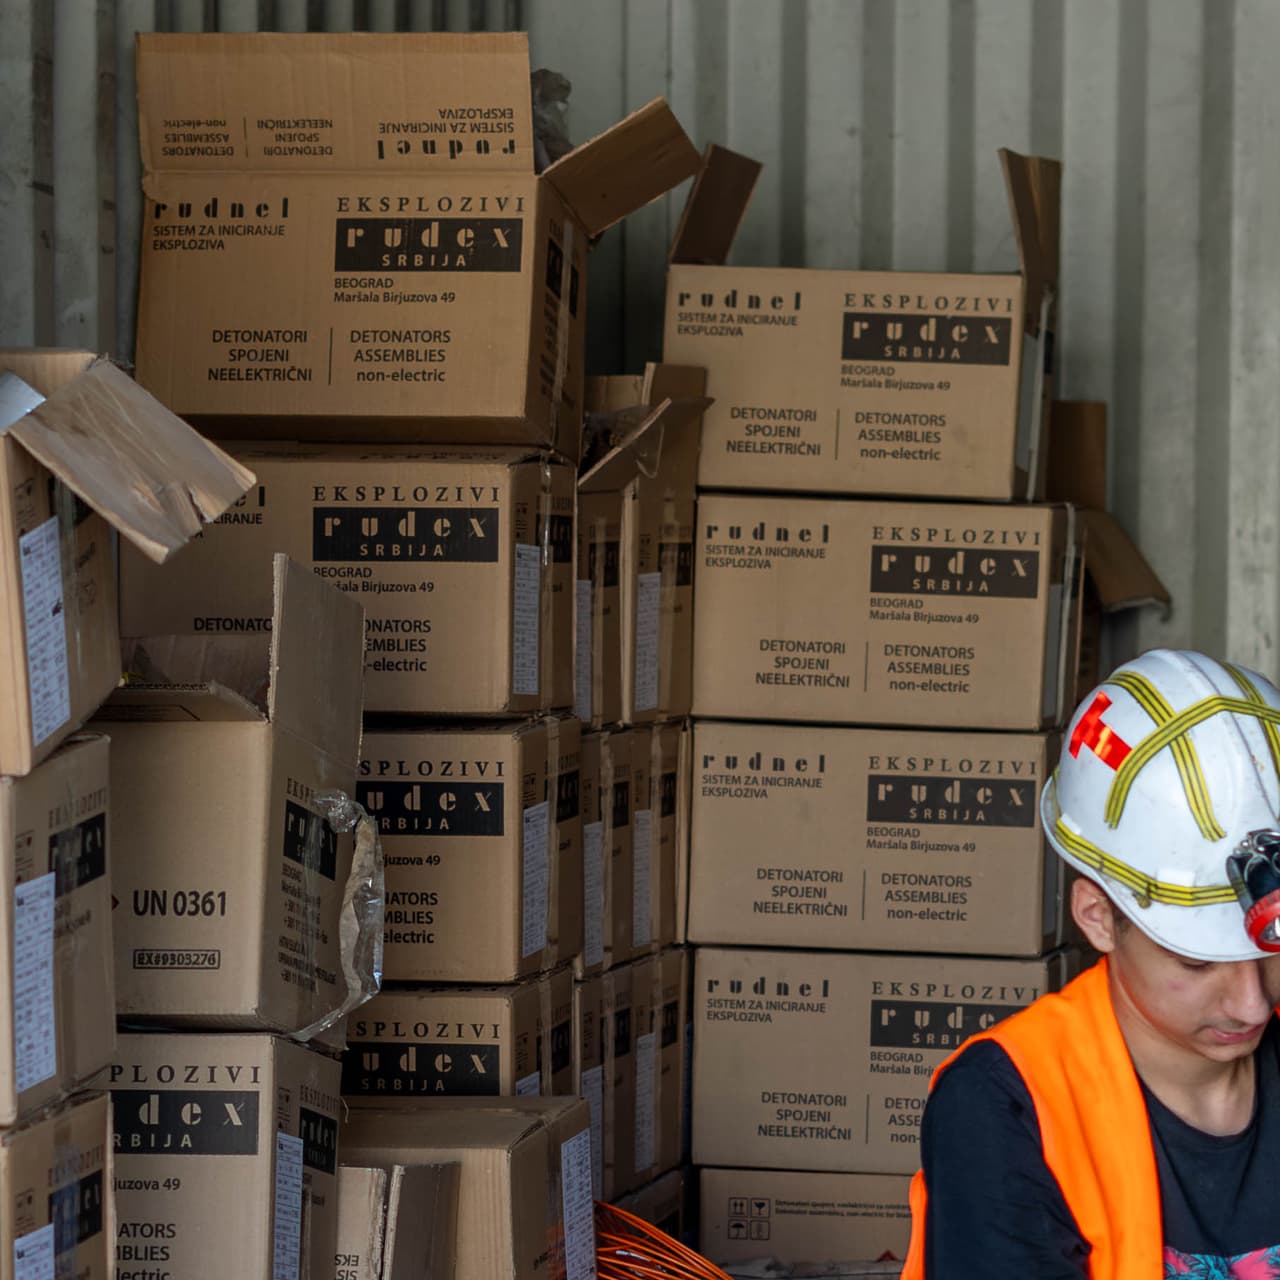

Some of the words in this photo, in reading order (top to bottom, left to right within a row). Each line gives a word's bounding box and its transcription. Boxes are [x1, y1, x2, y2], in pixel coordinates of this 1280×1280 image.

[439, 107, 514, 120] EKSPLOZIVA
[379, 122, 447, 134] INICIRANJE
[450, 122, 467, 134] ZA
[469, 122, 515, 134] SISTEM
[164, 132, 229, 143] ASSEMBLIES
[275, 132, 320, 143] SPOJENI
[162, 145, 234, 157] DETONATORS
[264, 145, 333, 156] DETONATORI
[377, 139, 516, 160] rudnel
[154, 197, 290, 220] rudnel
[337, 196, 525, 213] EKSPLOZIVI
[153, 224, 196, 237] SISTEM
[199, 224, 215, 237] ZA
[218, 224, 285, 236] INICIRANJE
[347, 221, 512, 249] rudex
[153, 239, 225, 251] EKSPLOZIVA
[382, 254, 467, 268] SRBIJA
[334, 277, 394, 289] BEOGRAD
[333, 290, 380, 304] Maršala
[383, 291, 438, 305] Birjuzova
[440, 291, 456, 303] 49
[678, 289, 802, 311] rudnel
[845, 292, 1014, 313] EKSPLOZIVI
[212, 329, 308, 344] DETONATORI
[350, 330, 451, 344] DETONATORS
[852, 318, 1000, 345] rudex
[228, 348, 289, 363] SPOJENI
[354, 348, 446, 363] ASSEMBLIES
[884, 345, 961, 360] SRBIJA
[208, 365, 312, 382] NEELEKTRIČNI
[356, 368, 446, 383] non-electric
[841, 365, 895, 377] BEOGRAD
[730, 406, 817, 422] DETONATORI
[855, 411, 946, 427] DETONATORS
[745, 424, 801, 439] SPOJENI
[858, 429, 941, 444] ASSEMBLIES
[726, 440, 821, 456] NEELEKTRIČNI
[860, 446, 941, 462] non-electric
[312, 486, 500, 502] EKSPLOZIVI
[324, 511, 487, 538] rudex
[706, 522, 830, 543] rudnel
[873, 526, 1041, 546] EKSPLOZIVI
[360, 543, 444, 557] SRBIJA
[881, 551, 1027, 577] rudex
[313, 566, 372, 578] BEOGRAD
[361, 581, 416, 594] Birjuzova
[419, 581, 435, 593] 49
[913, 578, 989, 593] SRBIJA
[870, 598, 924, 610] BEOGRAD
[194, 616, 273, 632] DETONATO
[365, 638, 426, 652] EMBLIES
[759, 639, 846, 655] DETONATORI
[366, 658, 427, 672] -electric
[774, 656, 830, 671] SPOJENI
[755, 671, 850, 689] NEELEKTRIČNI
[360, 760, 505, 776] SPLOZIVI
[868, 756, 1037, 776] EKSPLOZIVI
[877, 780, 1023, 806] rudex
[133, 889, 167, 916] UN
[173, 890, 226, 916] 0361
[707, 977, 830, 998] rudnel
[872, 981, 1040, 1001] EKSPLOZIVI
[870, 1051, 924, 1063] BEOGRAD
[108, 1063, 261, 1084] PLOZIVI
[361, 1077, 445, 1092] SRBIJA
[757, 1124, 852, 1141] NEELEKTRIČNI
